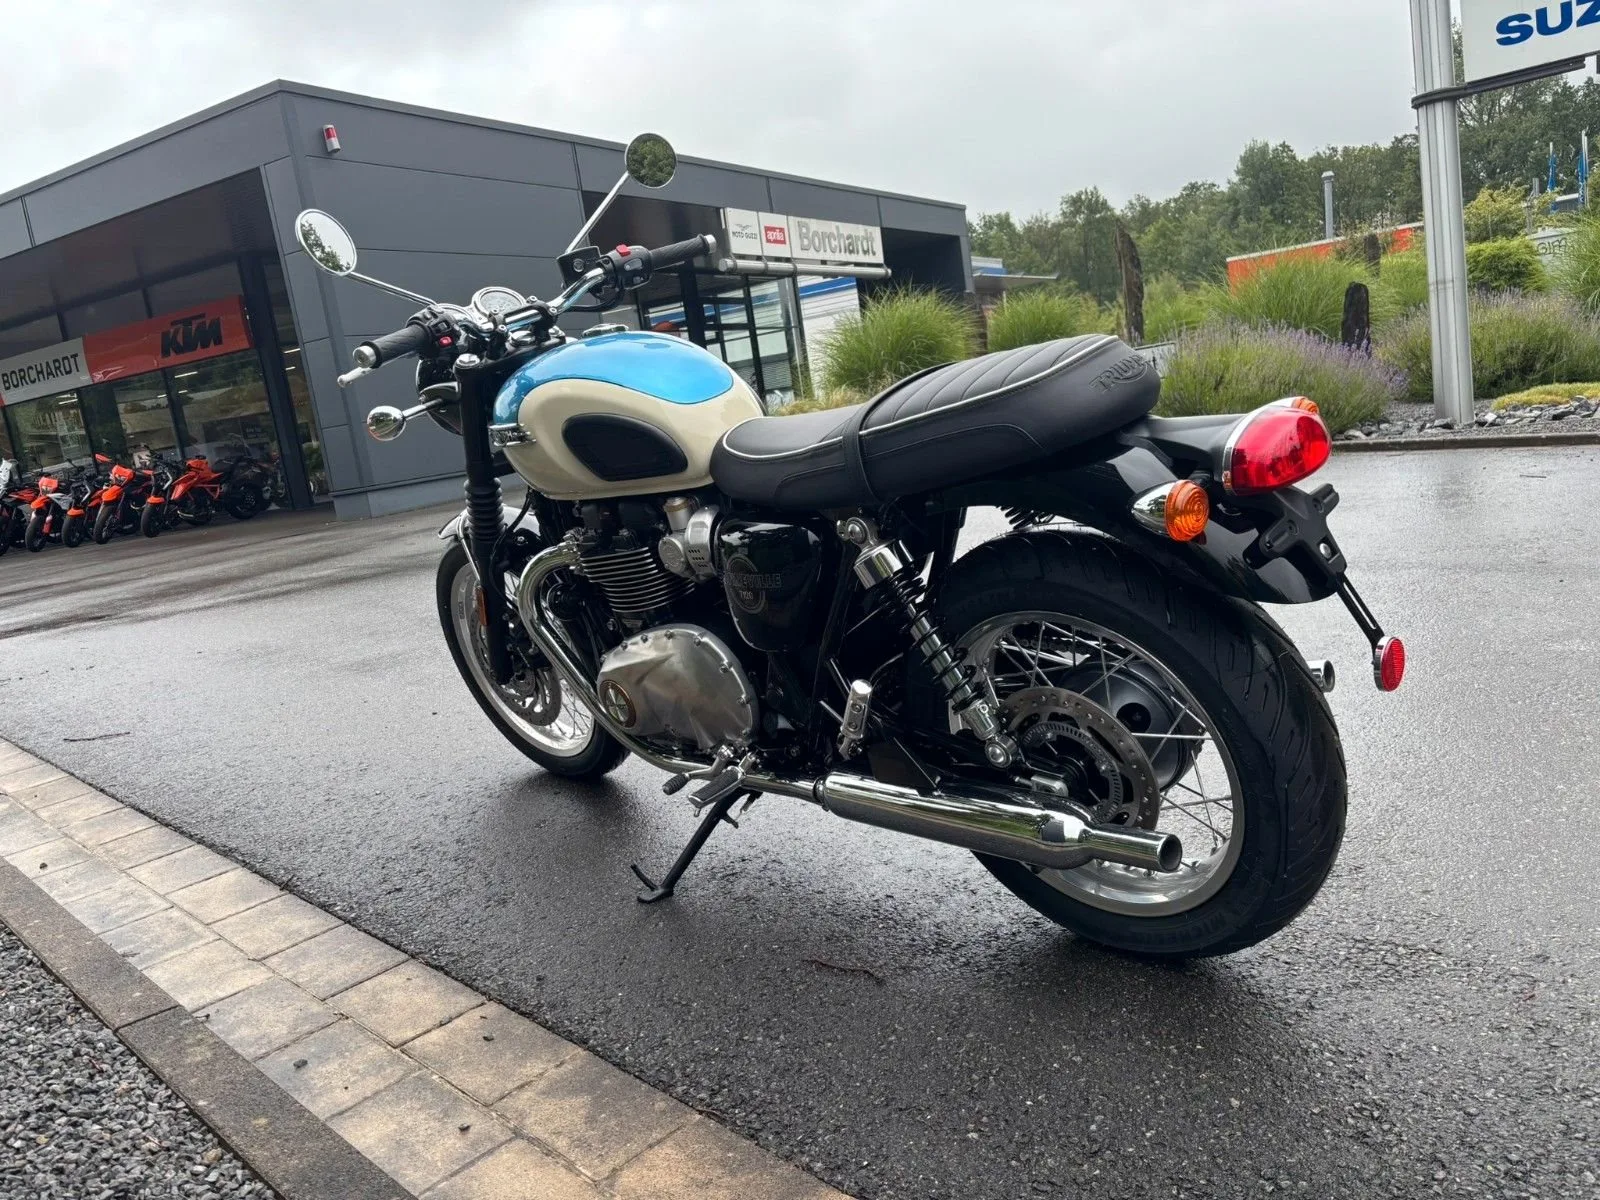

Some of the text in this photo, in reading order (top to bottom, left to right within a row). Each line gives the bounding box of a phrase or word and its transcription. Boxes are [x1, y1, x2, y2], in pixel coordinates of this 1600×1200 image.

[766, 229, 785, 242] aprilia
[797, 220, 876, 256] Borchardt
[161, 312, 223, 358] KTM
[1, 353, 80, 391] BORCHARDT
